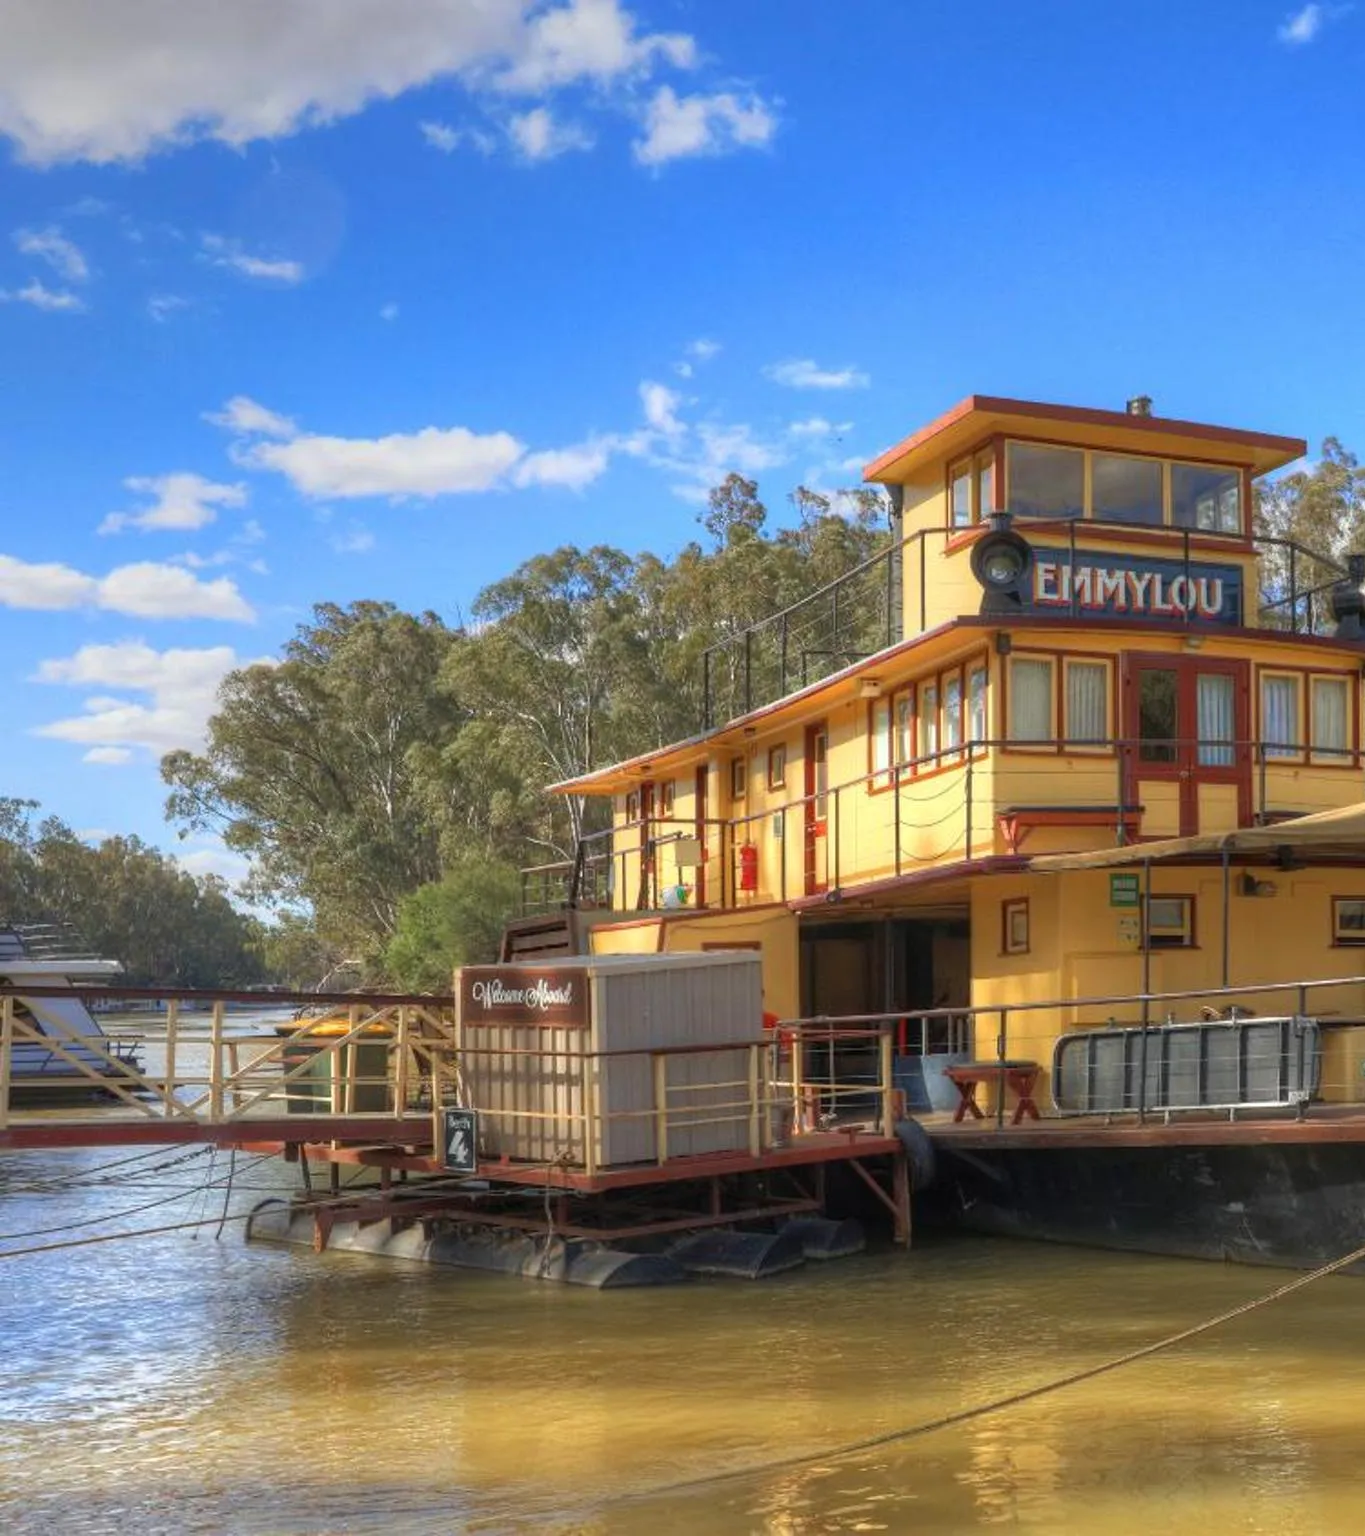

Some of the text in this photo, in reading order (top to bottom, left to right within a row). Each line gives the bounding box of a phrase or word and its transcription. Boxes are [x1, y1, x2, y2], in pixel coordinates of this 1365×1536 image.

[1034, 562, 1223, 617] EMMYLOU
[472, 978, 572, 1011] Welcome Aboard
[448, 1130, 468, 1163] 4
